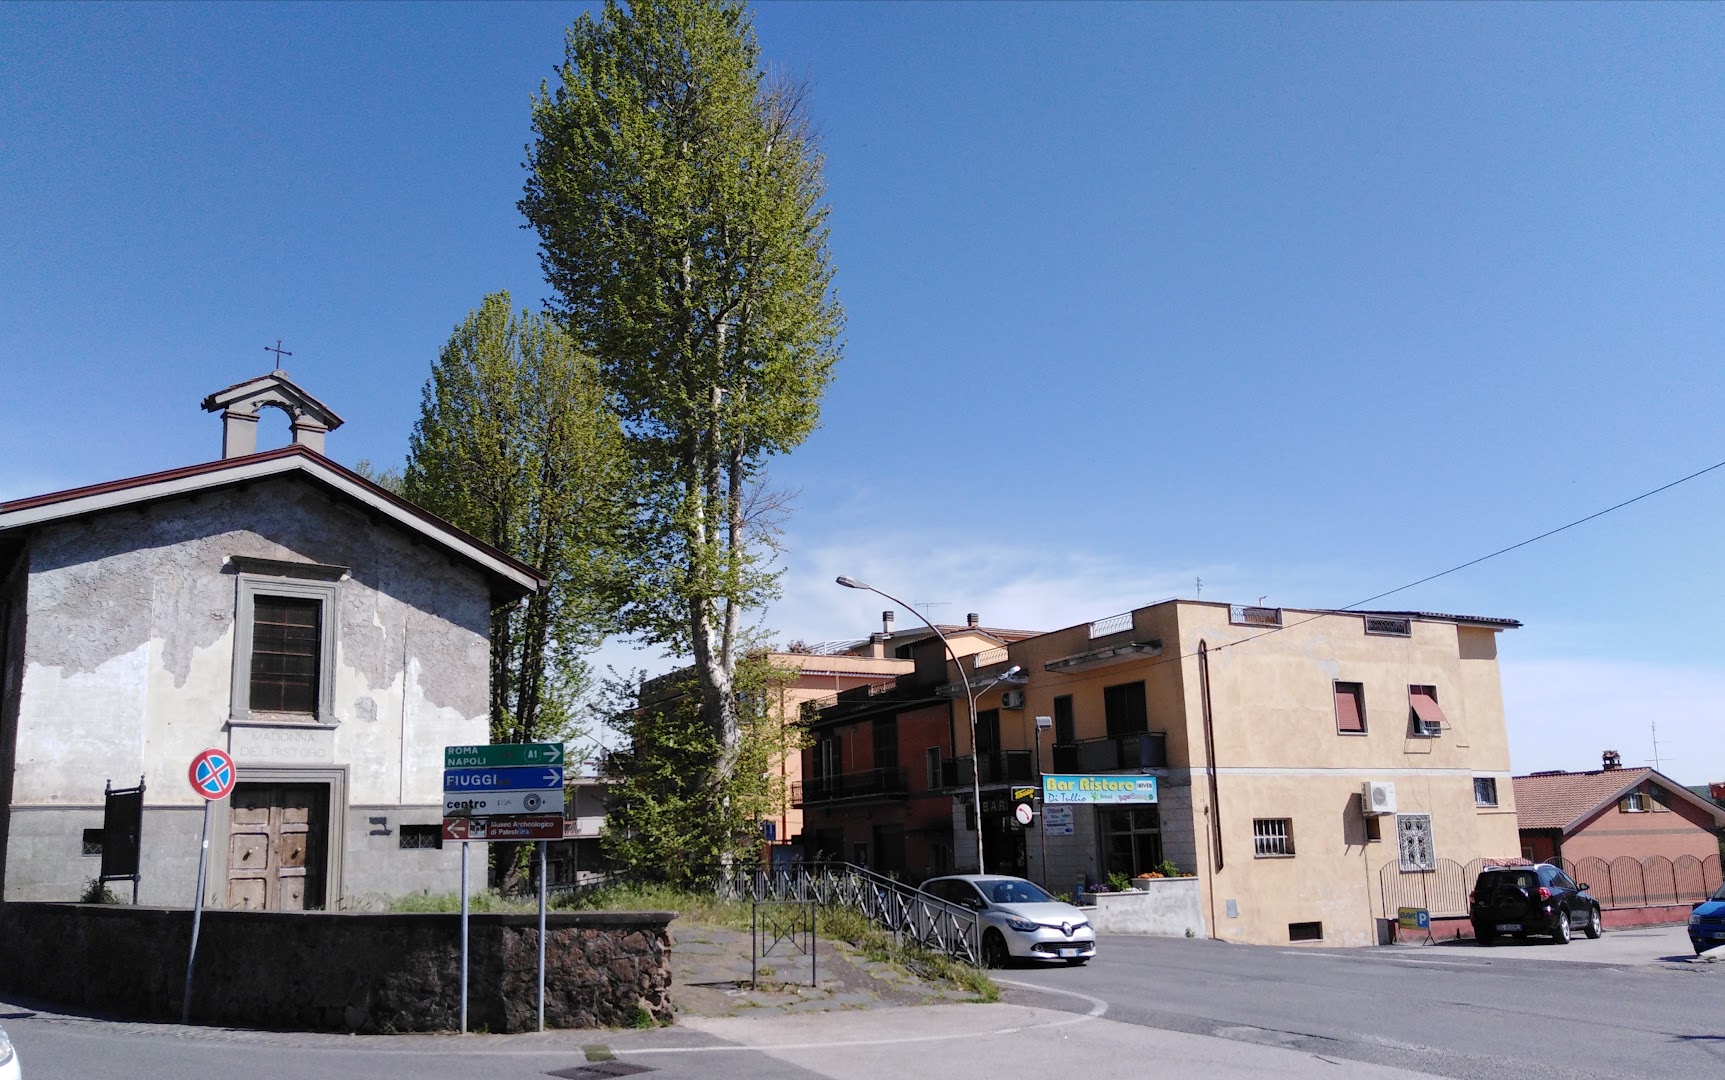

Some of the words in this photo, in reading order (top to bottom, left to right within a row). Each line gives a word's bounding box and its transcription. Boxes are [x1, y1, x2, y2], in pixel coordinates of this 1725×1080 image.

[251, 731, 315, 742] MADONNA
[240, 746, 269, 757] DEL
[272, 747, 325, 758] RISTORO
[448, 747, 478, 755] ROMA
[528, 750, 538, 758] A1
[447, 757, 486, 766] NAPOLI
[447, 774, 497, 786] FIUGGI
[1046, 777, 1075, 791] Bar
[1048, 793, 1059, 802] Di
[1060, 793, 1087, 802] Tullio
[447, 799, 487, 809] centro
[513, 820, 554, 829] Archeologico
[1418, 912, 1427, 925] P
